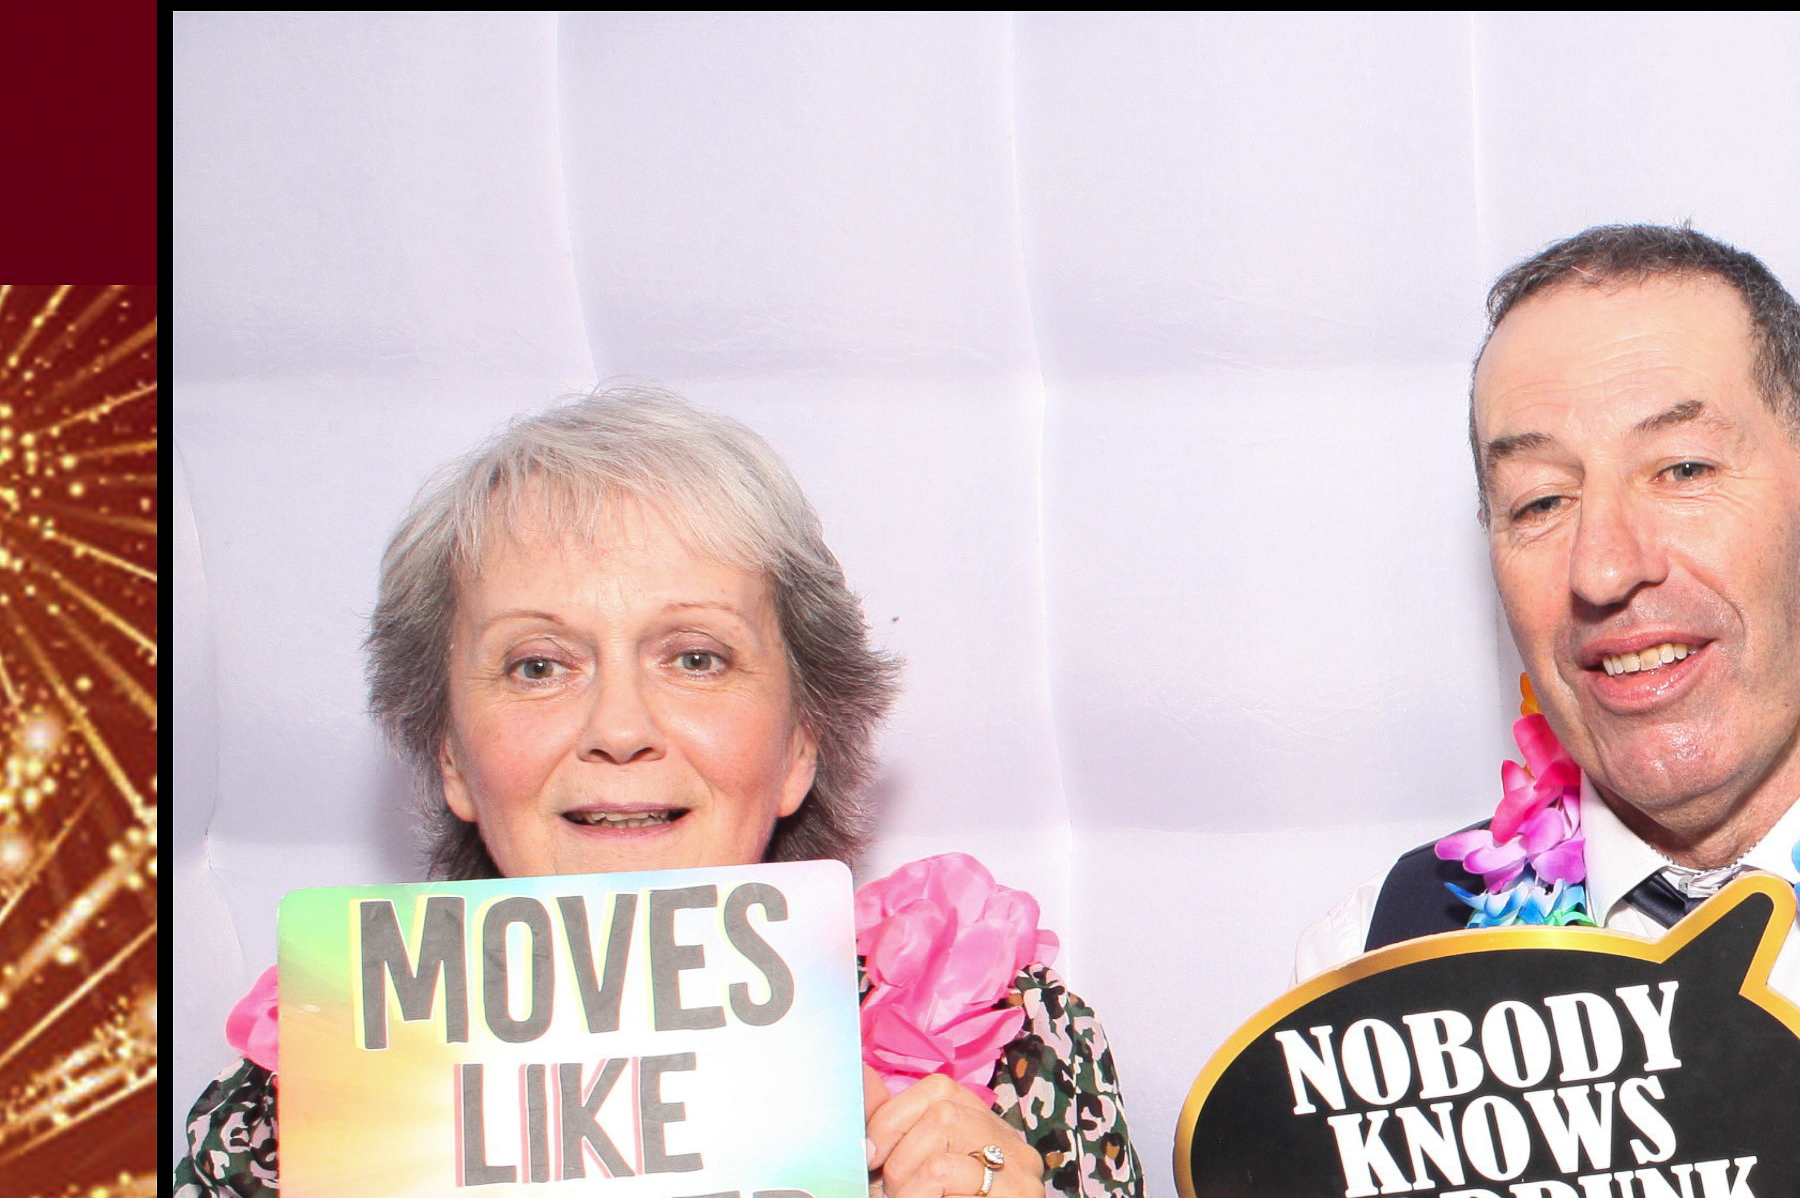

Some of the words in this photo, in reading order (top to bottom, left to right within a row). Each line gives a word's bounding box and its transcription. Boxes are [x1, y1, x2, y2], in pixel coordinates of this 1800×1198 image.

[350, 882, 794, 1050] MOVES
[1275, 981, 1682, 1115] NOBODY
[453, 1052, 703, 1187] LIKE
[1327, 1075, 1677, 1198] KNOWS
